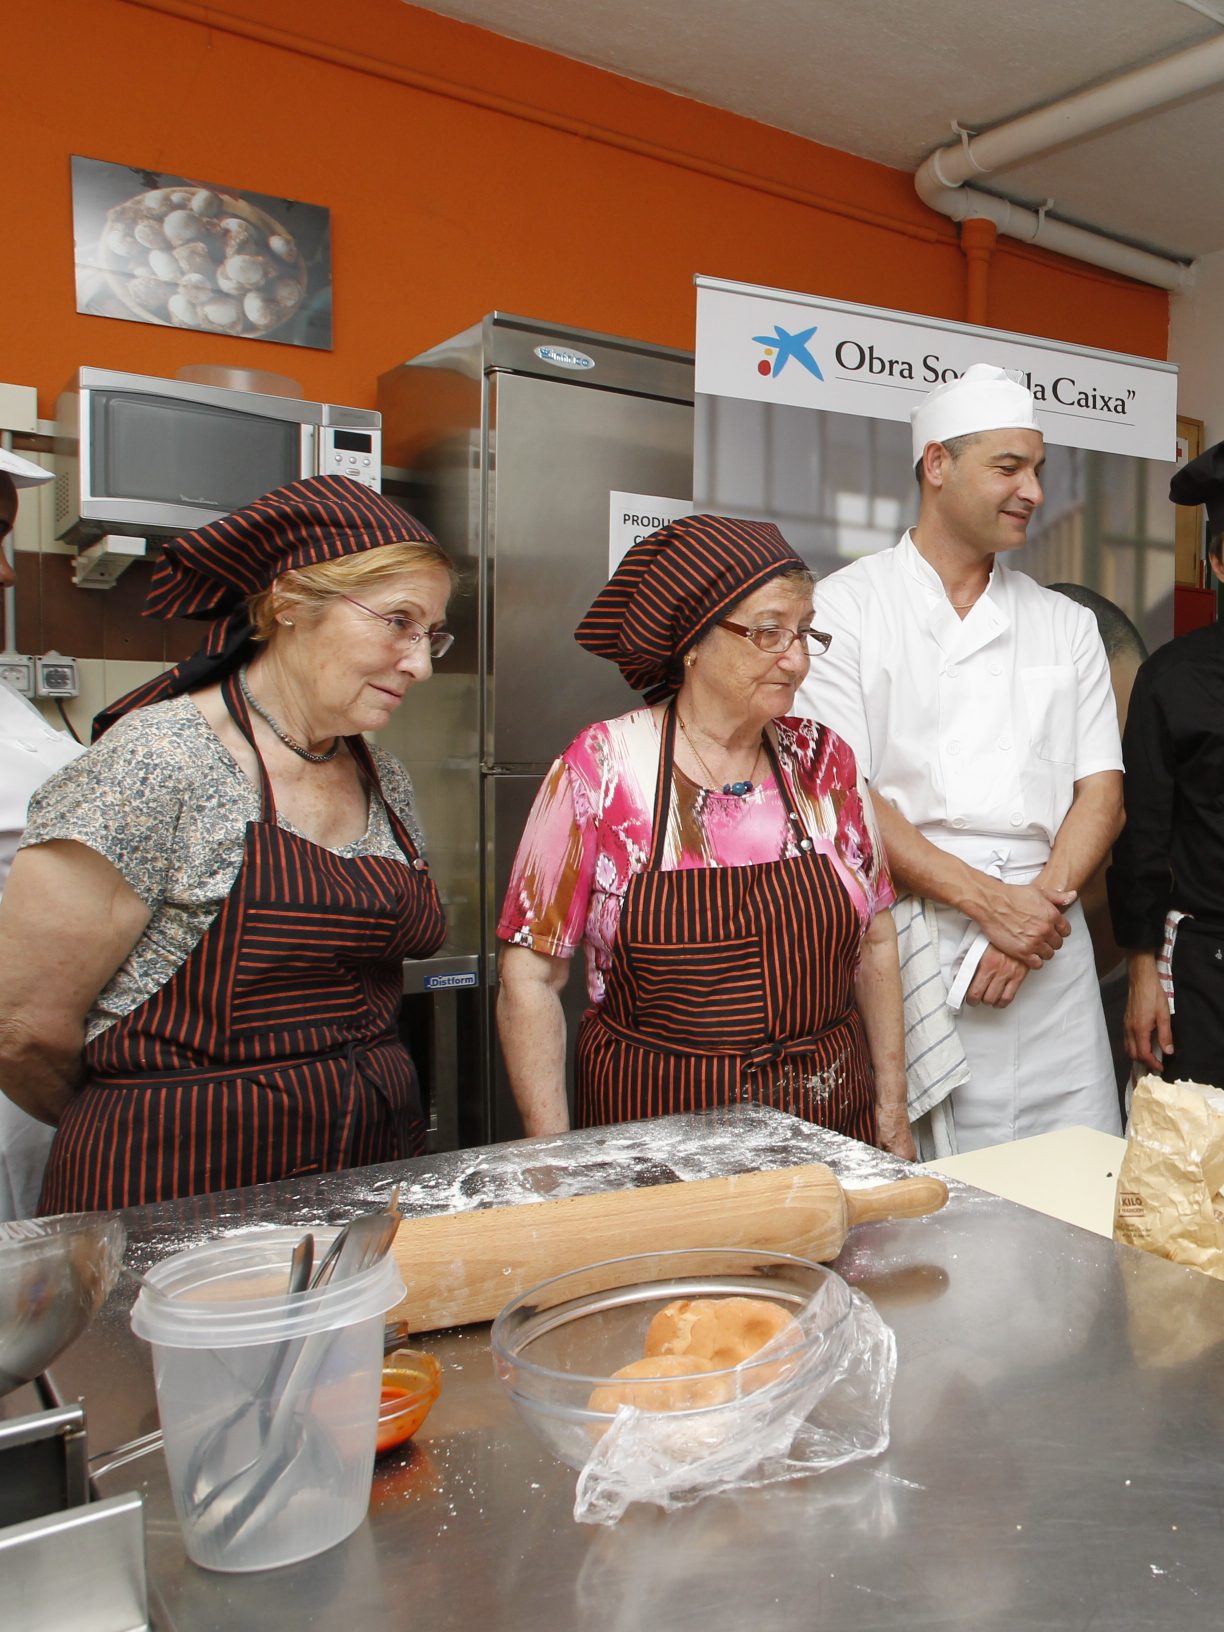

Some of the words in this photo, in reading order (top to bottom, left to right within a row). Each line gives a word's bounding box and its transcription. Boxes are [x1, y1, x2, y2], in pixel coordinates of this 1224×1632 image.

[835, 340, 914, 380] Obra
[623, 513, 671, 528] PRODU
[432, 976, 473, 986] Distform
